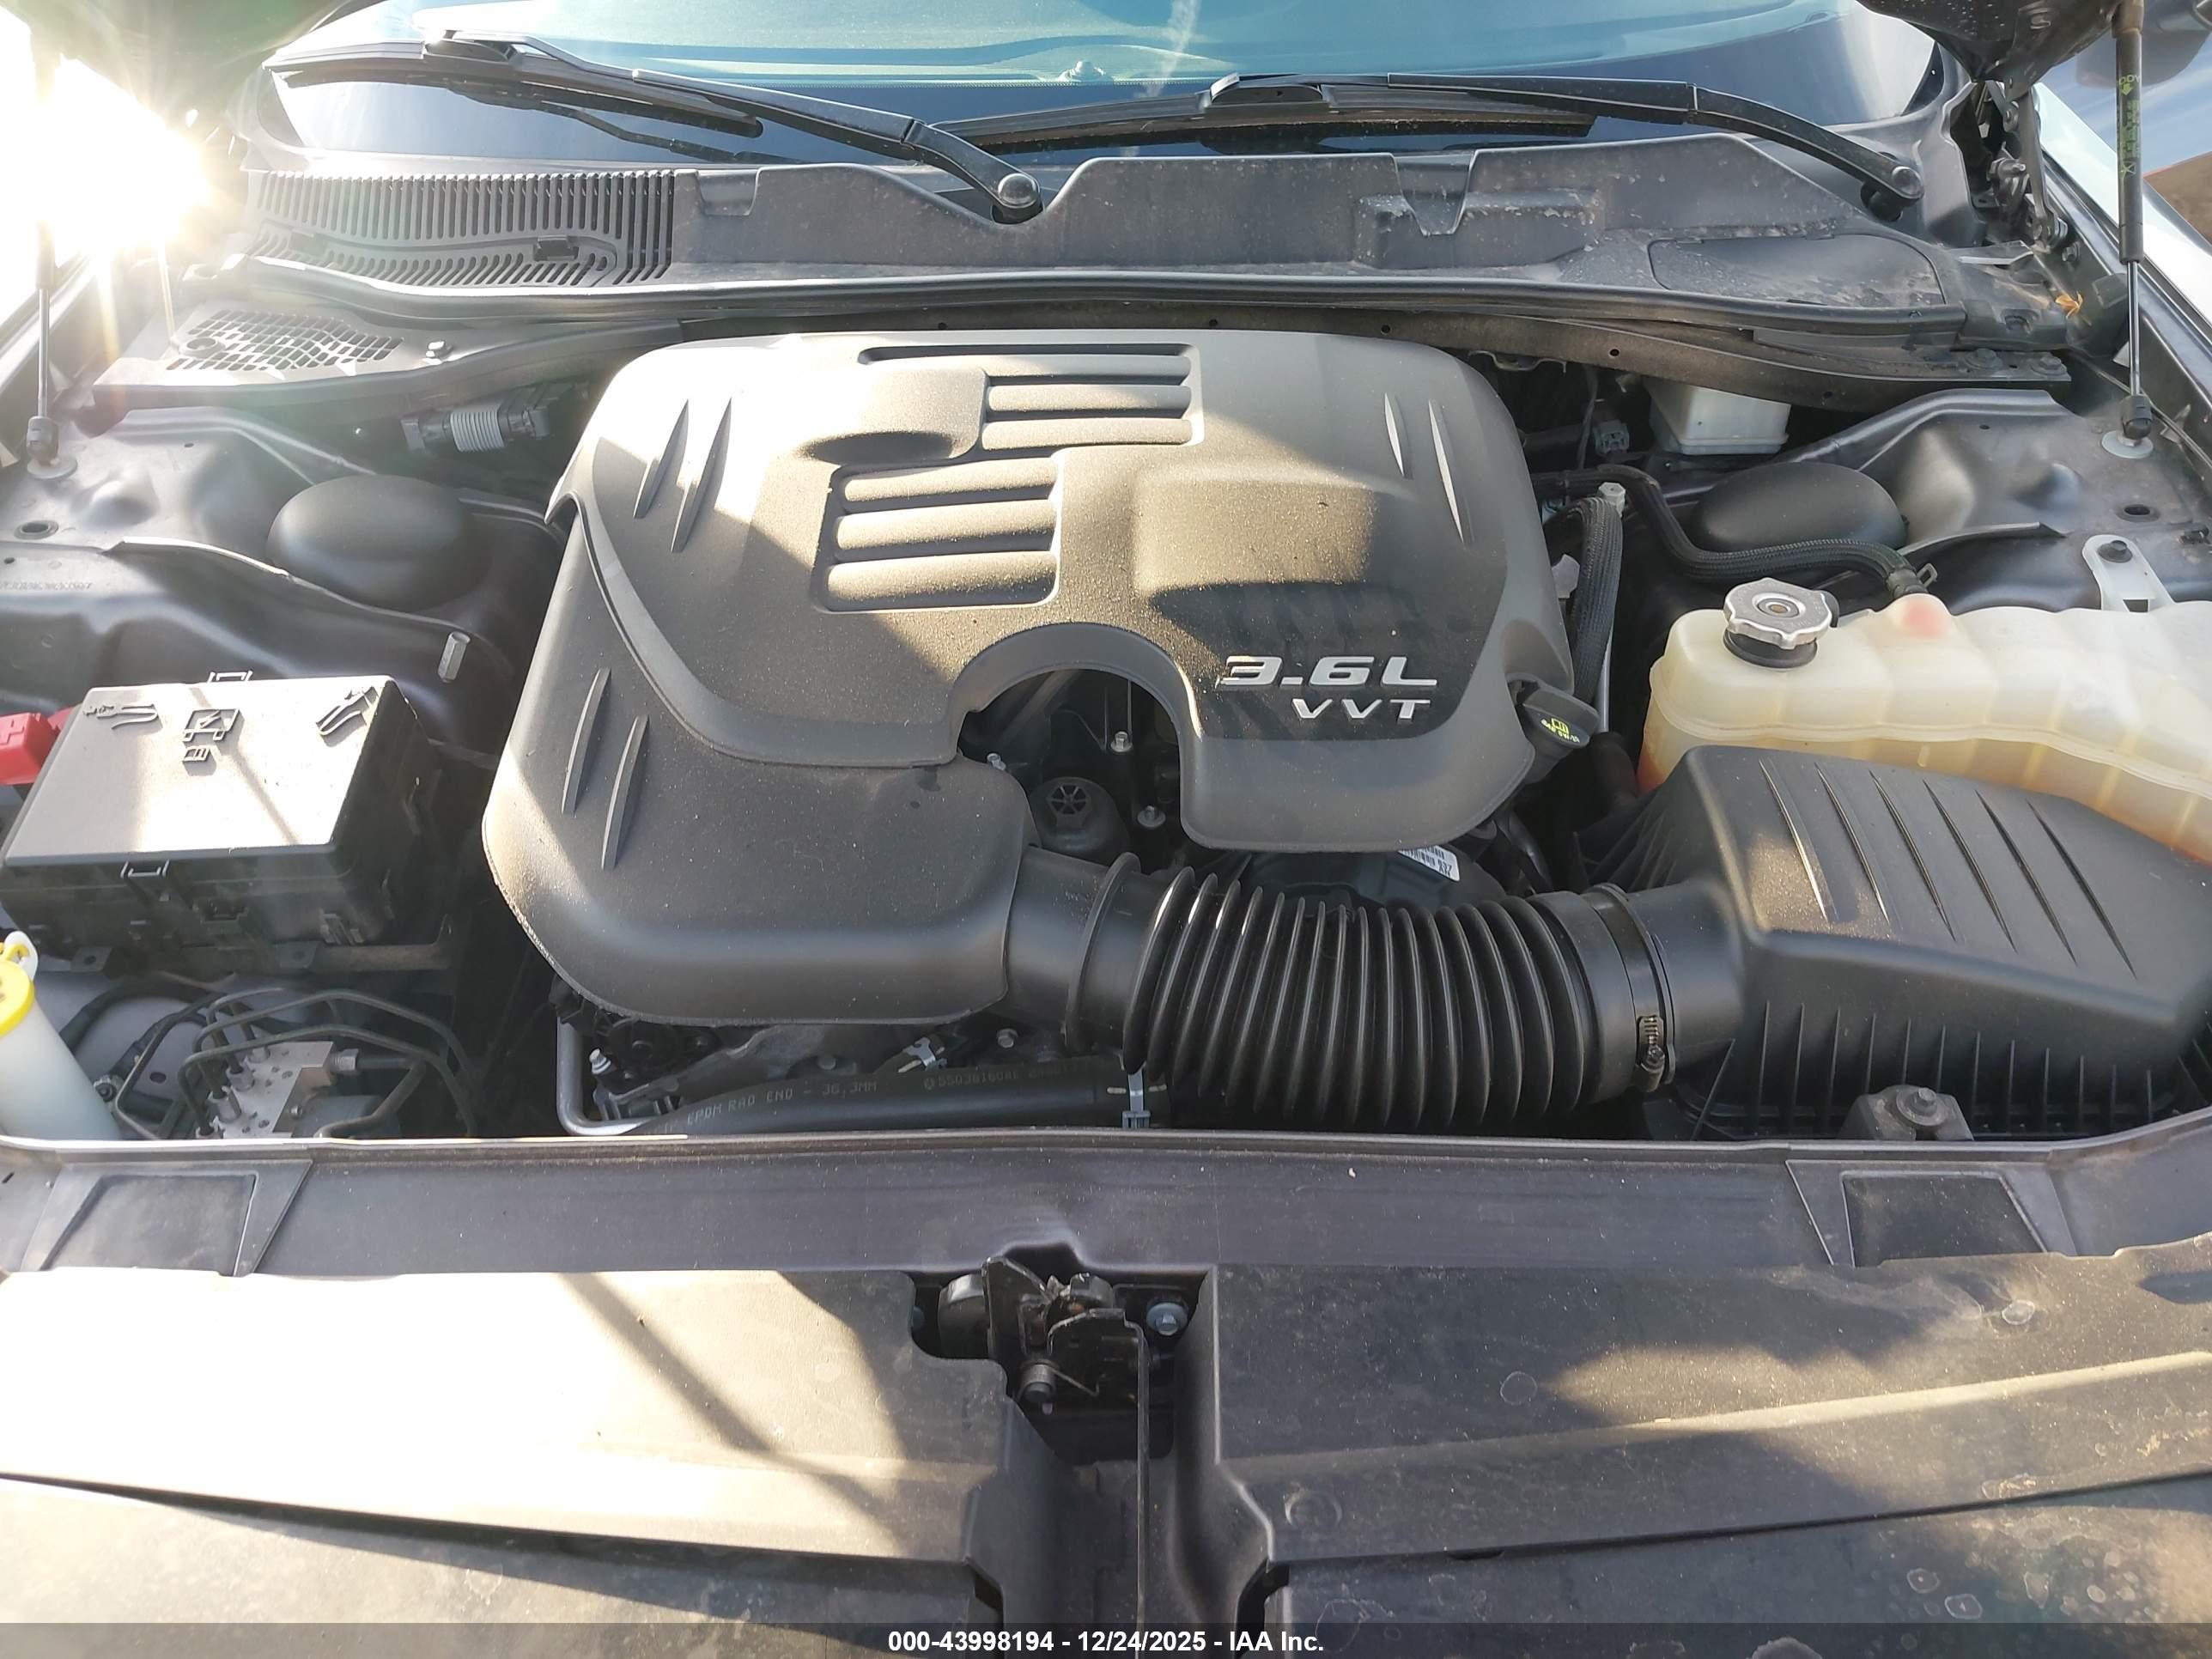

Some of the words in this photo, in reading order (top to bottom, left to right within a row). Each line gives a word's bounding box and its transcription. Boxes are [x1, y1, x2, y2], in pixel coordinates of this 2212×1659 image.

[1219, 656, 1437, 685] 3.6L
[1291, 698, 1431, 720] VVT
[728, 1094, 756, 1114] RAD
